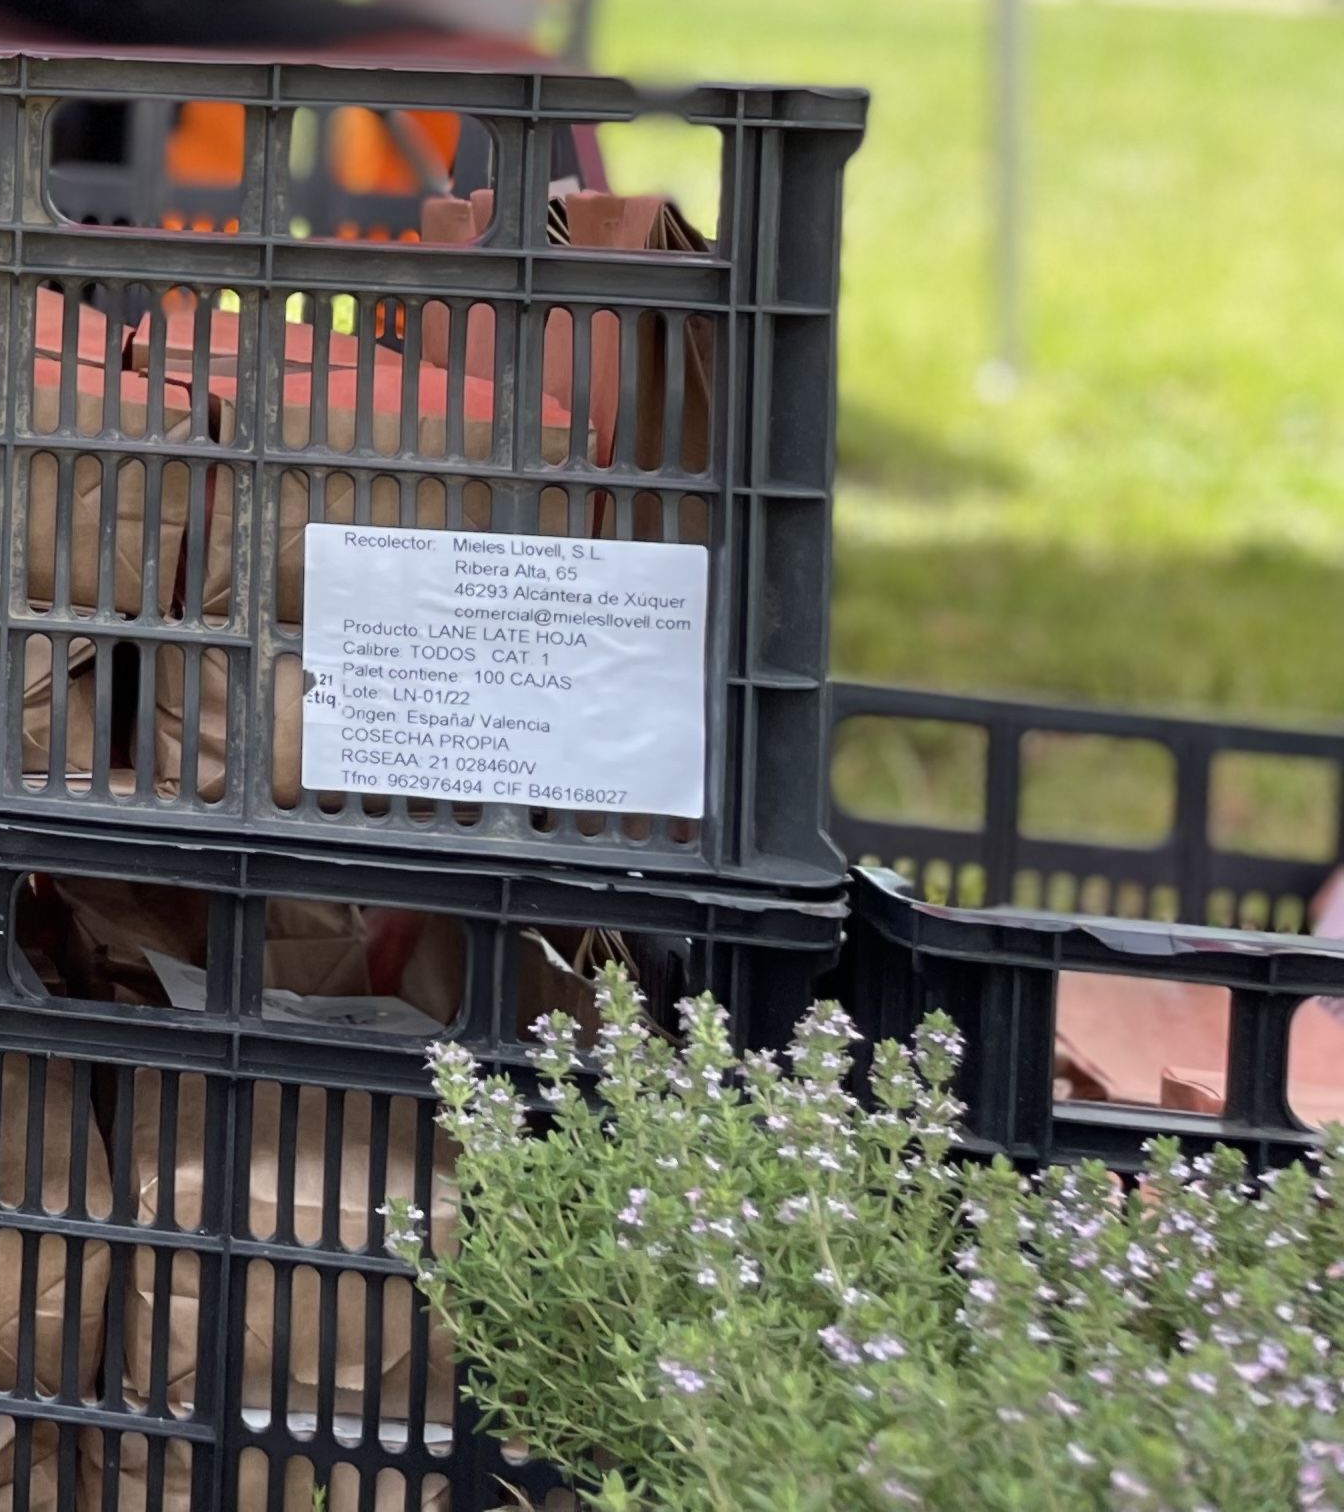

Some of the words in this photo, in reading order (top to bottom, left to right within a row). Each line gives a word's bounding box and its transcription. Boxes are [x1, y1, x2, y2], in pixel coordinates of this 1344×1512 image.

[452, 538, 505, 555] Mieles
[510, 540, 567, 559] Llovell,
[455, 560, 509, 576] Ribera
[515, 564, 550, 581] Alta,
[556, 566, 577, 581] 65
[454, 583, 508, 599] 46293
[513, 585, 592, 605] Alcántera
[597, 591, 619, 606] de
[623, 592, 685, 611] Xúquer
[428, 626, 477, 640] LANE
[483, 628, 530, 644] LATE
[536, 631, 587, 647] HOJA
[410, 645, 476, 661] TODOS
[542, 652, 549, 666] 1
[319, 673, 333, 686] 21
[343, 662, 384, 679] Palet
[475, 670, 505, 685] 100
[510, 672, 572, 690] CAJAS
[392, 687, 471, 706] LN-01/22
[480, 714, 551, 733] Valencia
[341, 727, 434, 746] COSECHA
[439, 734, 510, 751] PROPIA
[387, 773, 482, 794] 962976494
[492, 780, 521, 796] CIF
[528, 784, 628, 805] B46168027
